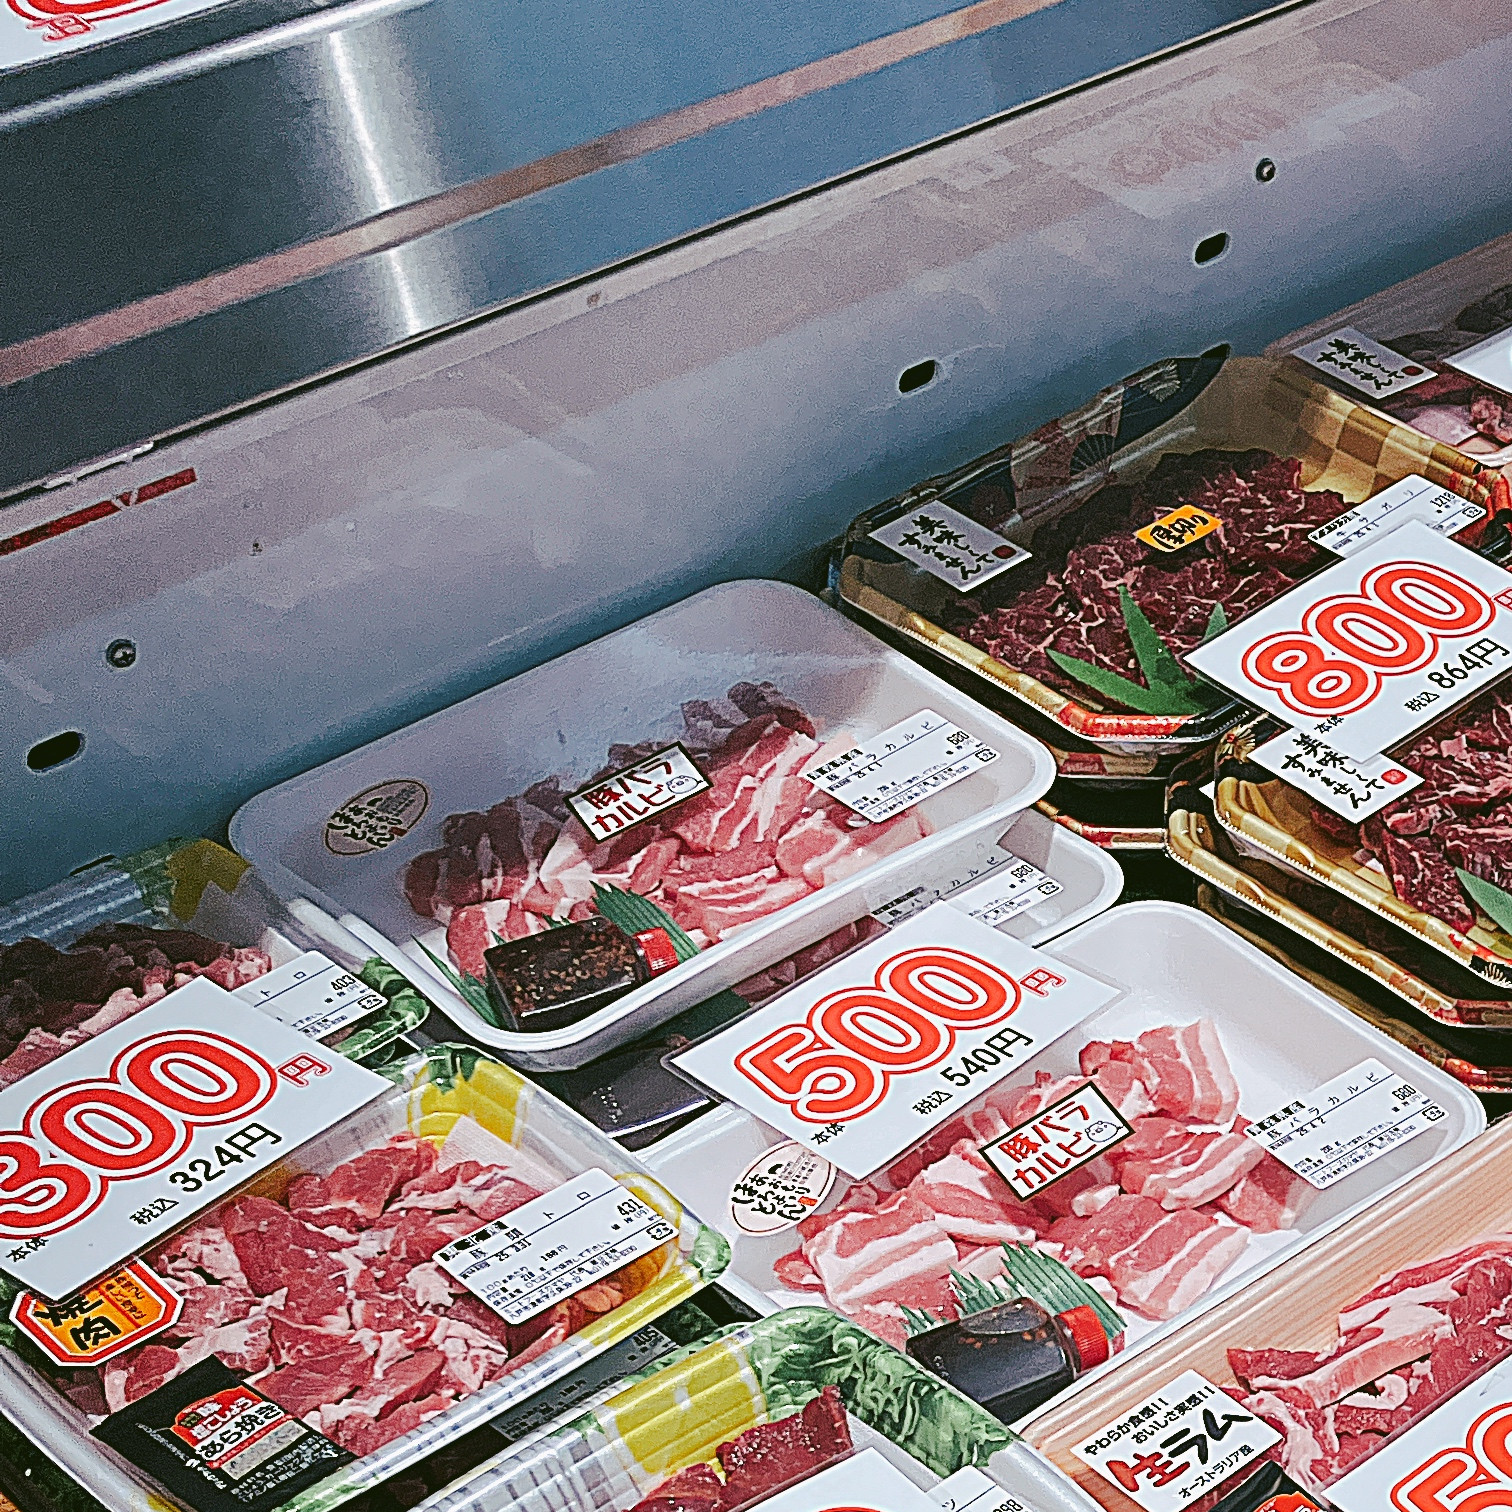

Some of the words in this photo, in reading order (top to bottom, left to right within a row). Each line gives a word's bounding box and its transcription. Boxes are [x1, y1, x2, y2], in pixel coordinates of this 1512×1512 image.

[1404, 691, 1440, 713] 税込
[1428, 637, 1511, 690] 864円
[586, 757, 674, 809] 豚バラ
[591, 781, 682, 835] カルビ
[733, 946, 1067, 1125] 500円
[910, 1088, 955, 1117] 税込
[938, 1025, 1036, 1090] 540円
[811, 1122, 845, 1145] 本体
[998, 1102, 1095, 1161] 豚バラ
[1008, 1119, 1095, 1190] カルビ
[129, 1197, 180, 1228] 税込
[169, 1121, 283, 1194] 324円
[5, 1235, 49, 1265] 本体
[1105, 1402, 1255, 1500] 生ラム
